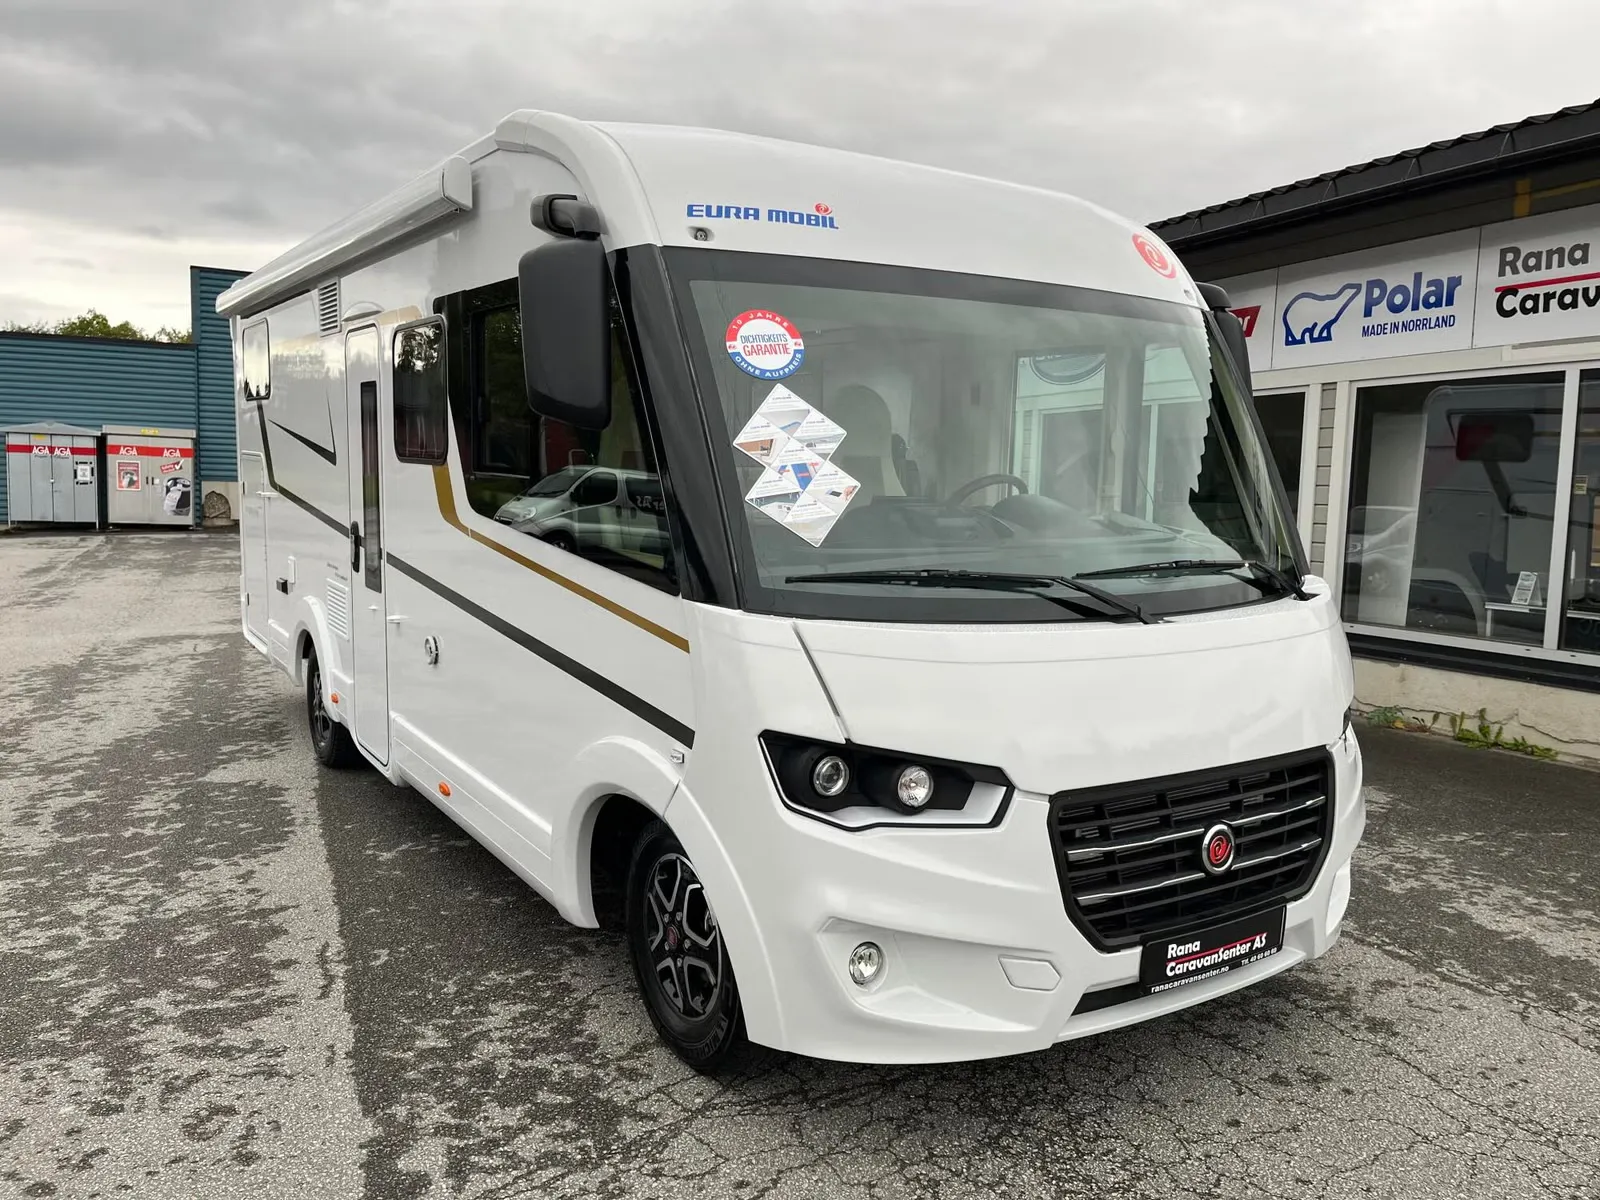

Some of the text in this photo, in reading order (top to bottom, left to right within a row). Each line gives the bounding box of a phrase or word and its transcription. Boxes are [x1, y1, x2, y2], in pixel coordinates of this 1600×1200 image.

[687, 204, 839, 230] EURA MOBIL
[1497, 242, 1590, 278] Rana
[1363, 271, 1462, 318] Polar
[731, 312, 789, 330] 10 JAHRE
[1361, 314, 1456, 338] MADE IN NORRLAND
[740, 333, 788, 345] DICHTIGKEITS
[743, 343, 791, 357] GARANTIE
[735, 353, 802, 378] OHNE AUFPREIS
[32, 445, 72, 456] AGA AGA
[119, 446, 138, 456] AGA
[162, 448, 181, 458] AGA
[1166, 933, 1267, 977] CaravanSenter AS
[1167, 940, 1201, 959] Rana
[1151, 965, 1230, 993] ranacaravansenter.no
